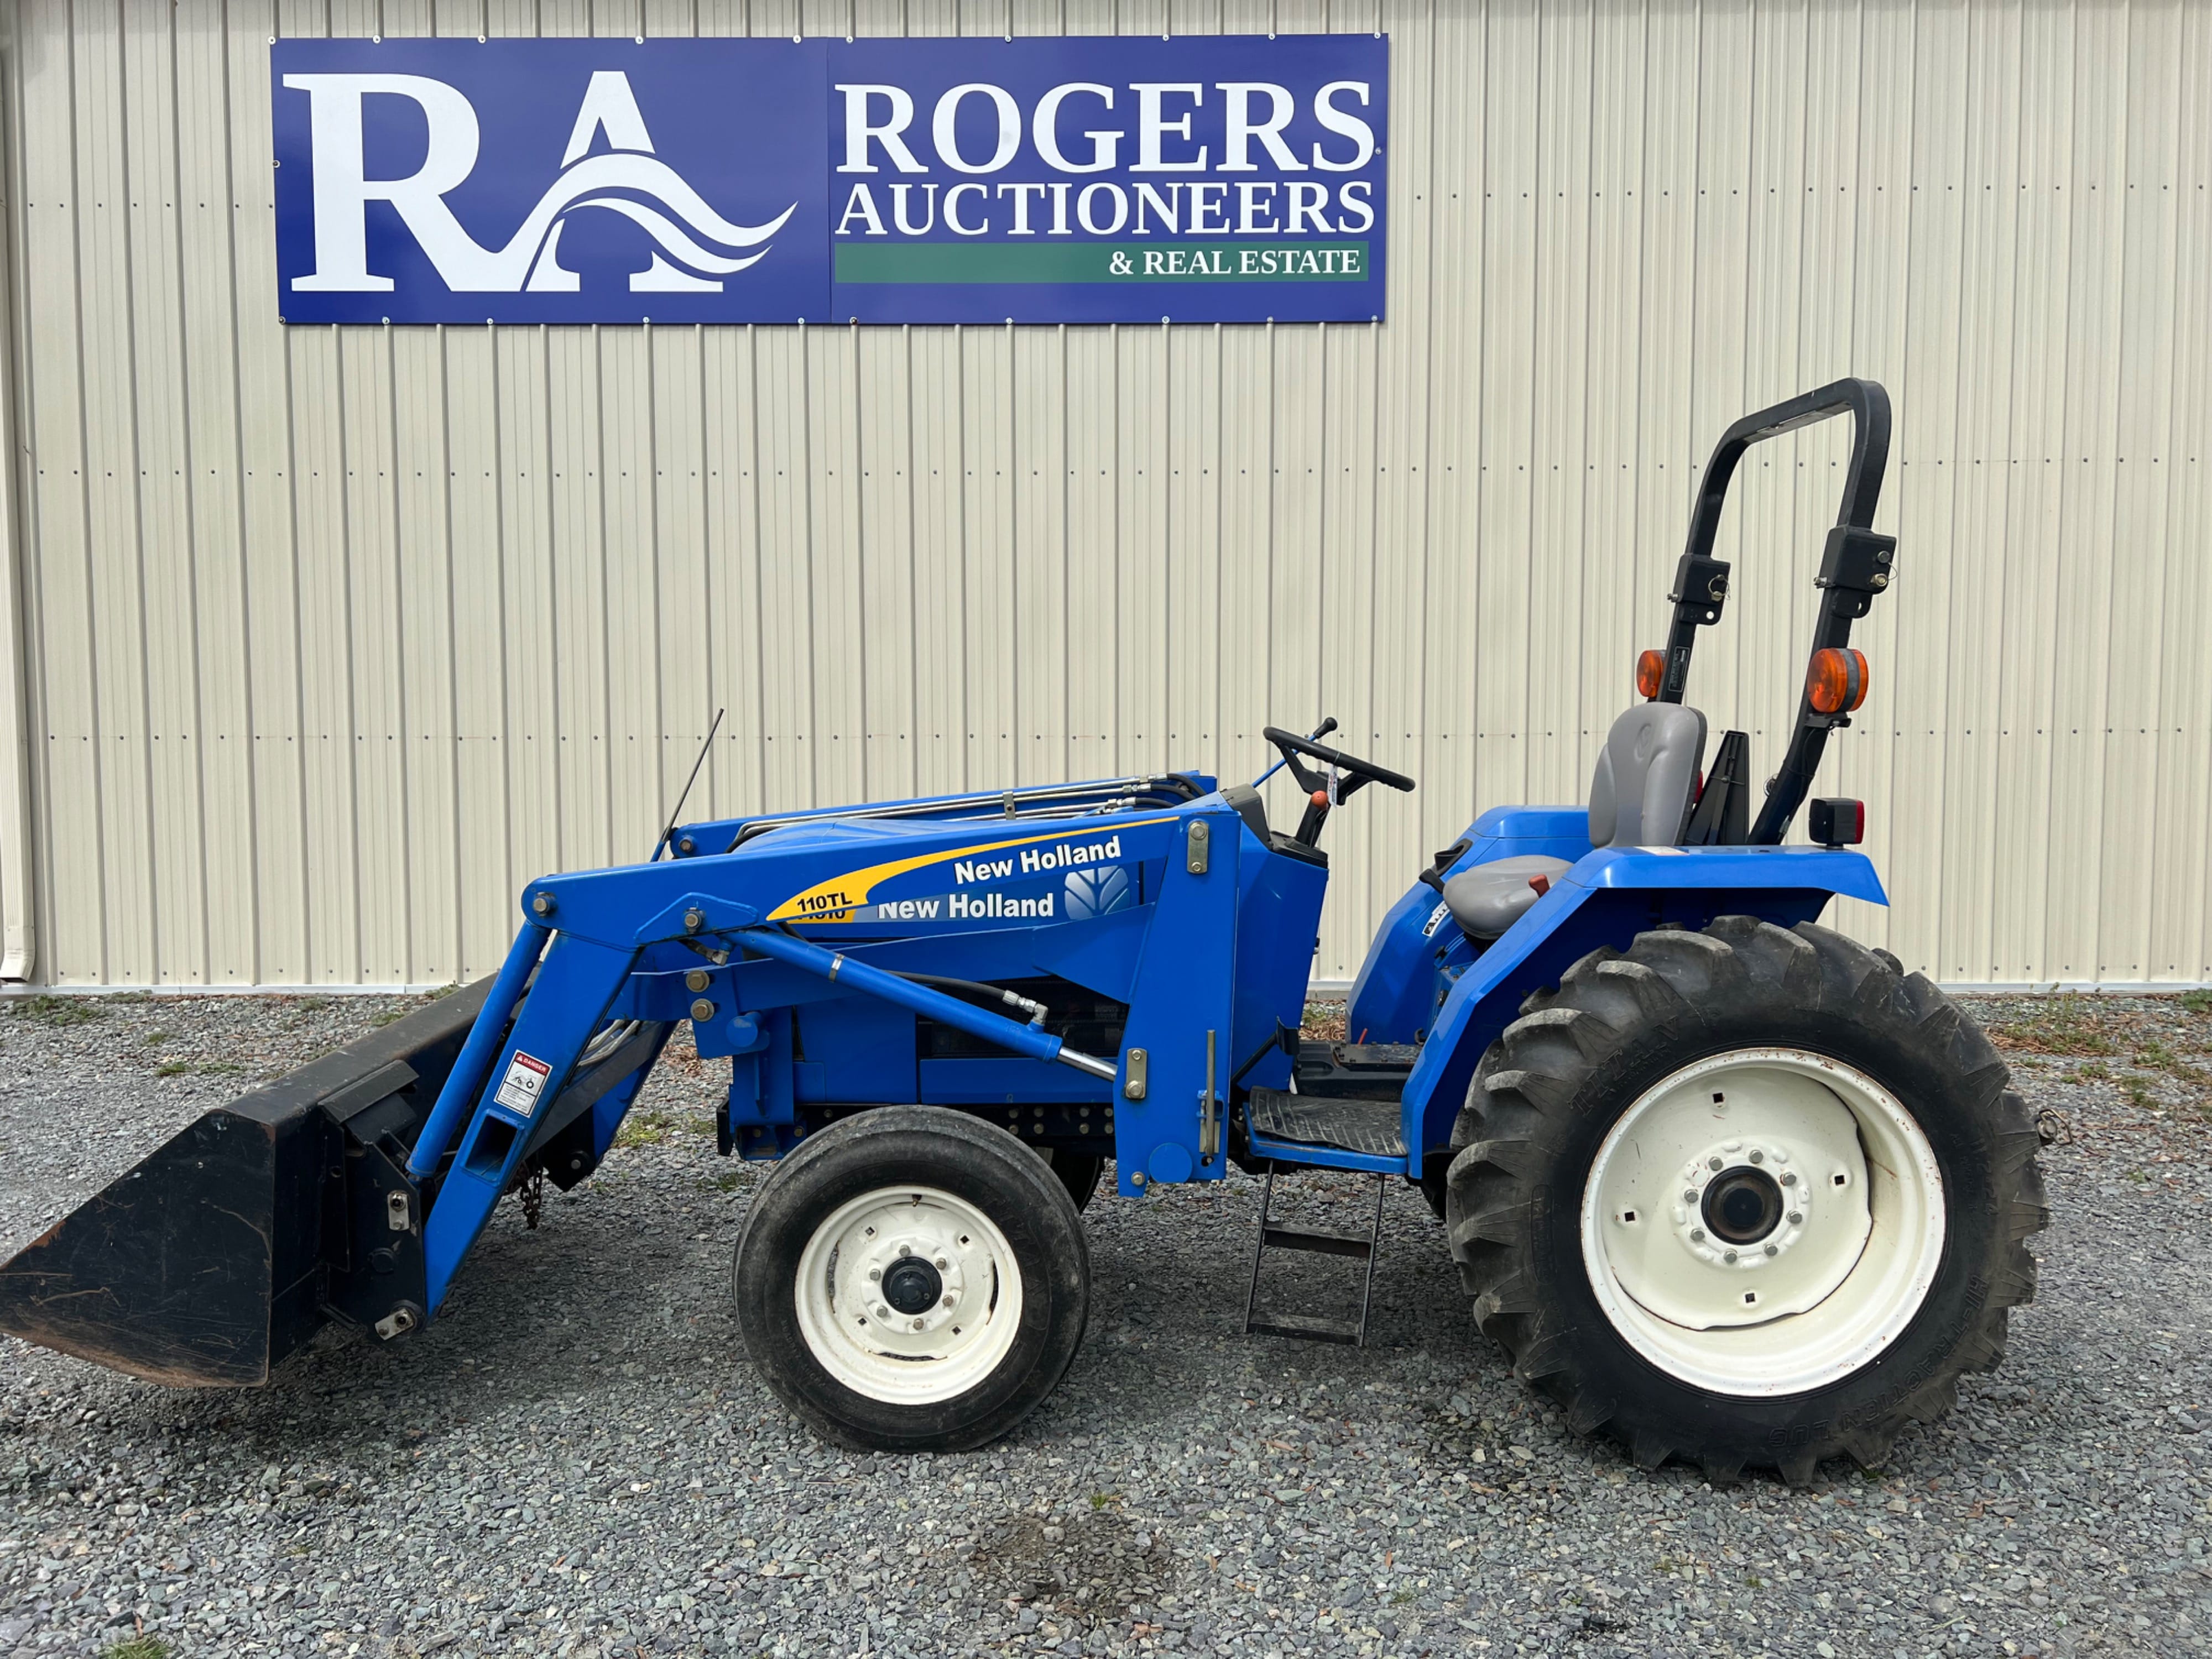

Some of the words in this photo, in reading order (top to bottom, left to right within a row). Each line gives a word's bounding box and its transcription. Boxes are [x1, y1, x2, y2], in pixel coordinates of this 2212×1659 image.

[835, 81, 1374, 173] ROGERS
[835, 181, 1374, 235] AUCTIONEERS
[1109, 251, 1134, 275] &
[1143, 250, 1232, 274] REAL
[1239, 249, 1360, 274] ESTATE
[954, 859, 1013, 884] New
[1020, 835, 1121, 873] Holland
[797, 891, 853, 912] 110TL
[879, 900, 940, 919] New
[948, 893, 1053, 918] Holland
[523, 1057, 547, 1073] DANGER
[1769, 1420, 1829, 1447] LUG
